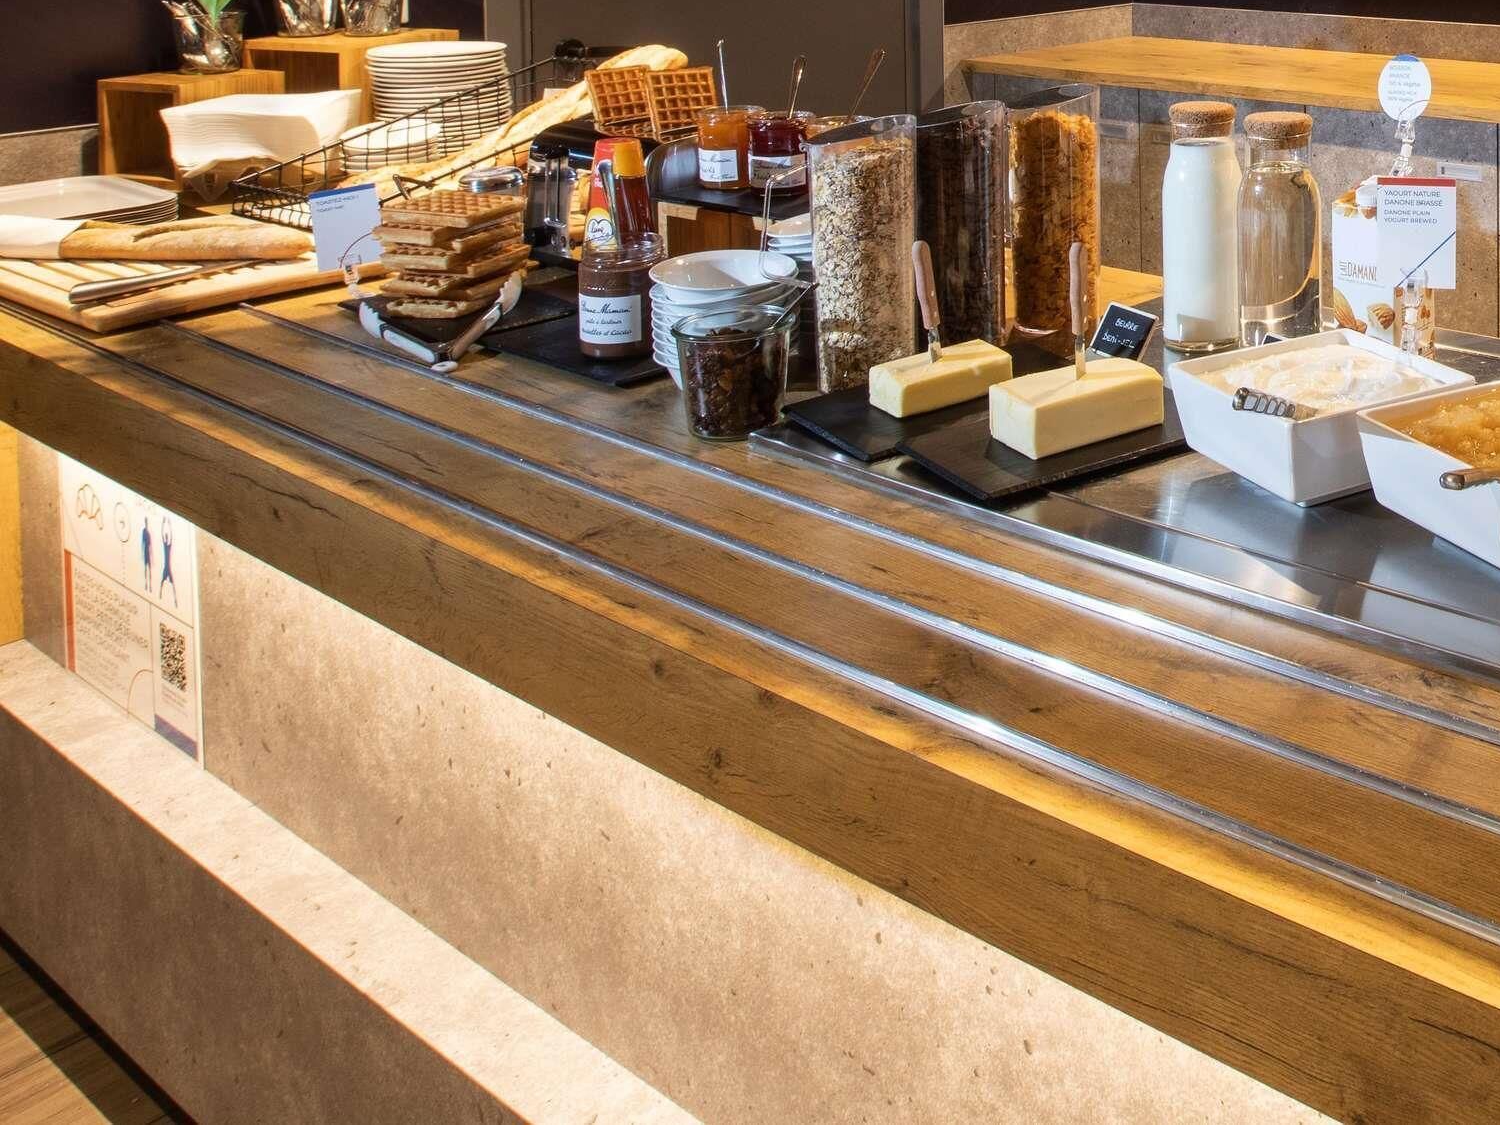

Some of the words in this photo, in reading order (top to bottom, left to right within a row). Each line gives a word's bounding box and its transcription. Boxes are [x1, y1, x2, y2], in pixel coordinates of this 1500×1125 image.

[1384, 190, 1412, 198] YAOURT
[1413, 190, 1441, 198] NATURE
[1384, 199, 1415, 207] DANONE
